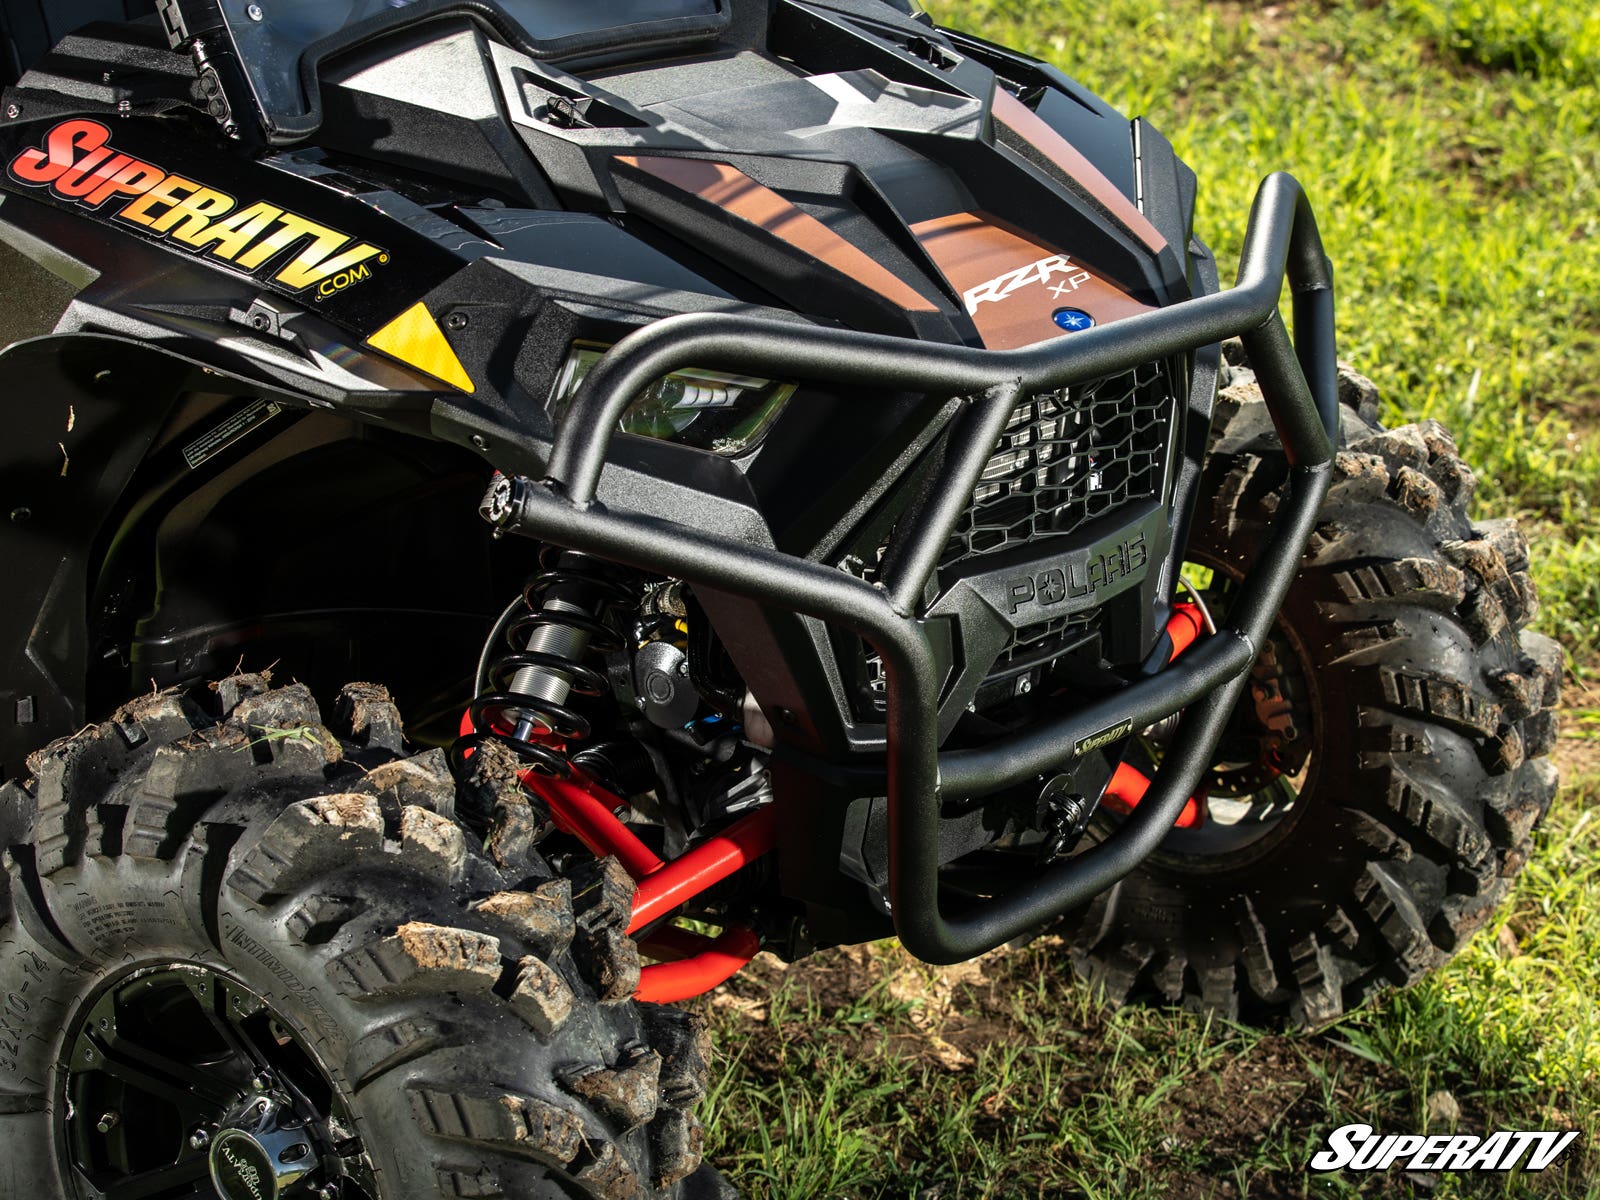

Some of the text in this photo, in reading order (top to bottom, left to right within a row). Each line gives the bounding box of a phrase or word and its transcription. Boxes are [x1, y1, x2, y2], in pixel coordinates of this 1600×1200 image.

[13, 119, 382, 289] SUPERATV
[317, 264, 370, 300] .COM
[963, 254, 1079, 317] RZR
[1046, 271, 1091, 300] XP
[1006, 532, 1148, 615] POLARIS
